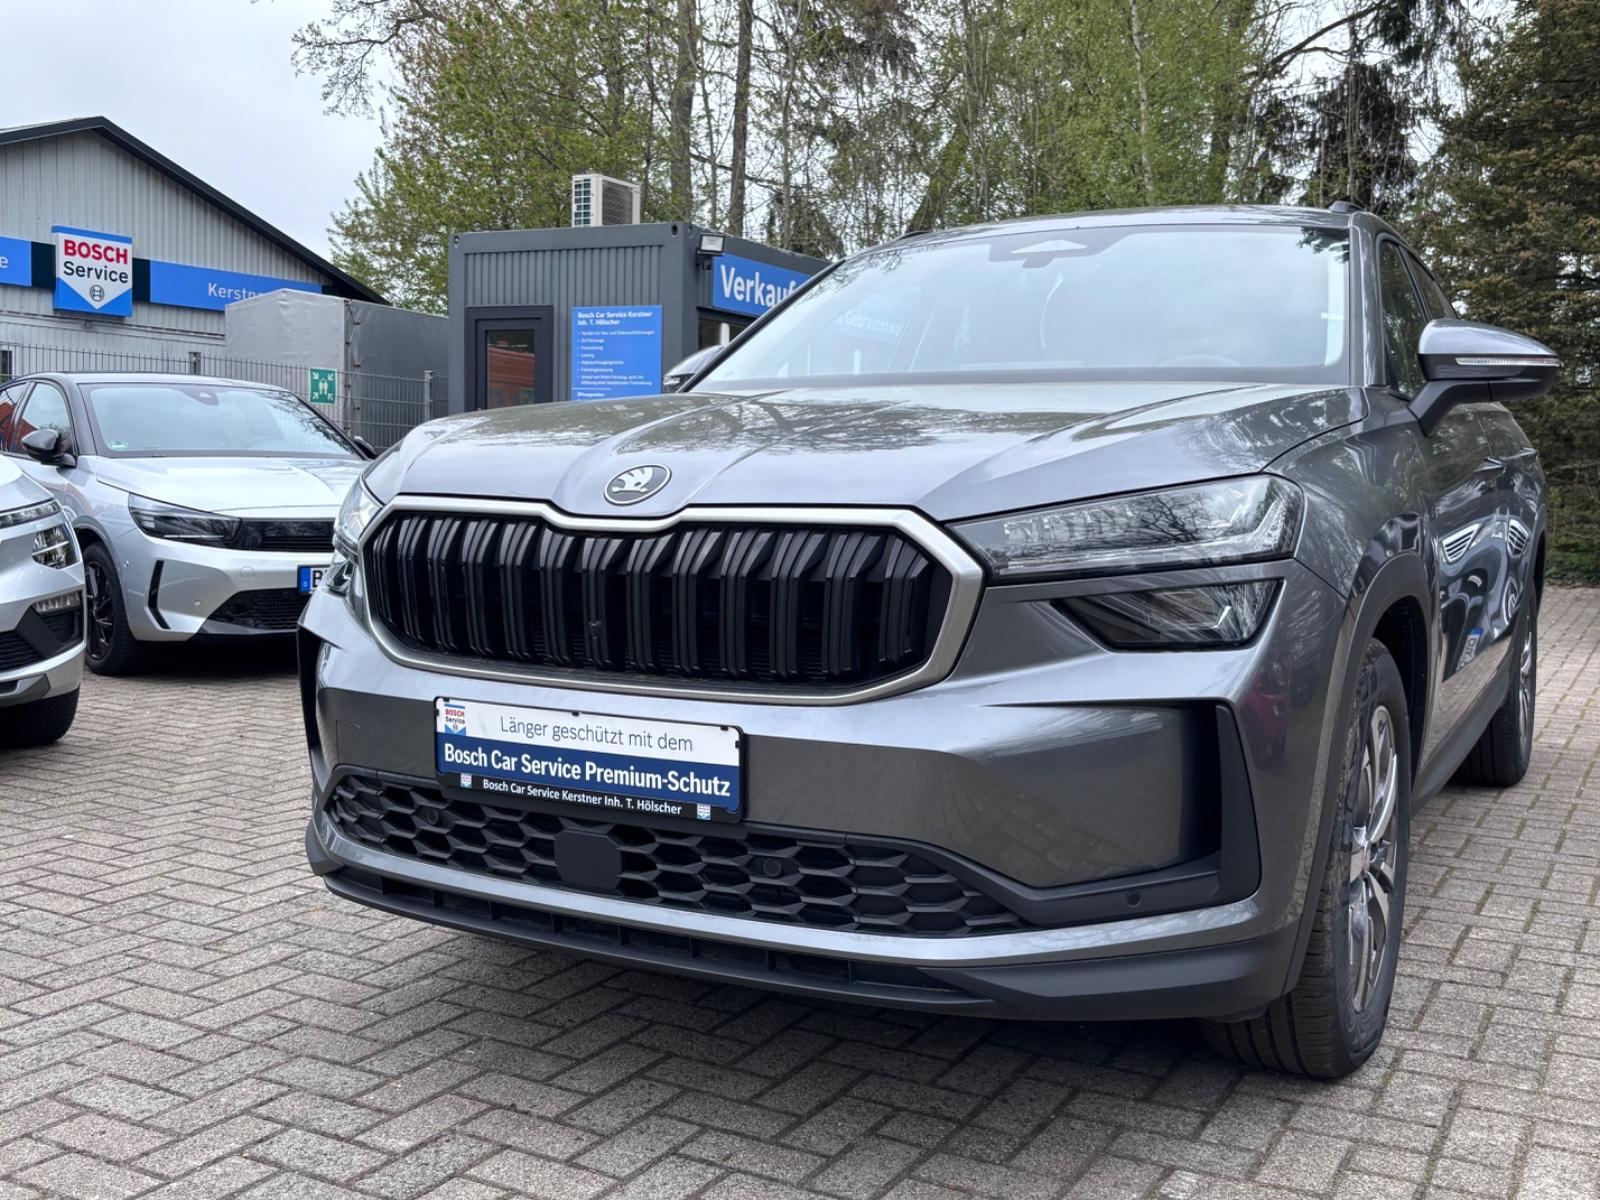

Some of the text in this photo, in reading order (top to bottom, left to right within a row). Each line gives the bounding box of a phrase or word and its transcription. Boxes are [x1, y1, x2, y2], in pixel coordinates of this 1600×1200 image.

[64, 239, 128, 264] BOSCH
[63, 261, 129, 283] Service
[207, 282, 264, 300] Kerstn
[445, 708, 465, 717] BOSCH
[445, 716, 466, 725] Service
[500, 716, 694, 751] Länger geschützt mit dem
[444, 743, 731, 797] Bosch Car Service Premium-Schutz
[483, 779, 509, 792] Bosch
[510, 783, 526, 794] Car
[527, 785, 560, 799] Service
[561, 790, 602, 804] Kerstner
[604, 796, 624, 808] Inh.
[625, 798, 635, 809] T.
[636, 801, 682, 815] Hölscher
